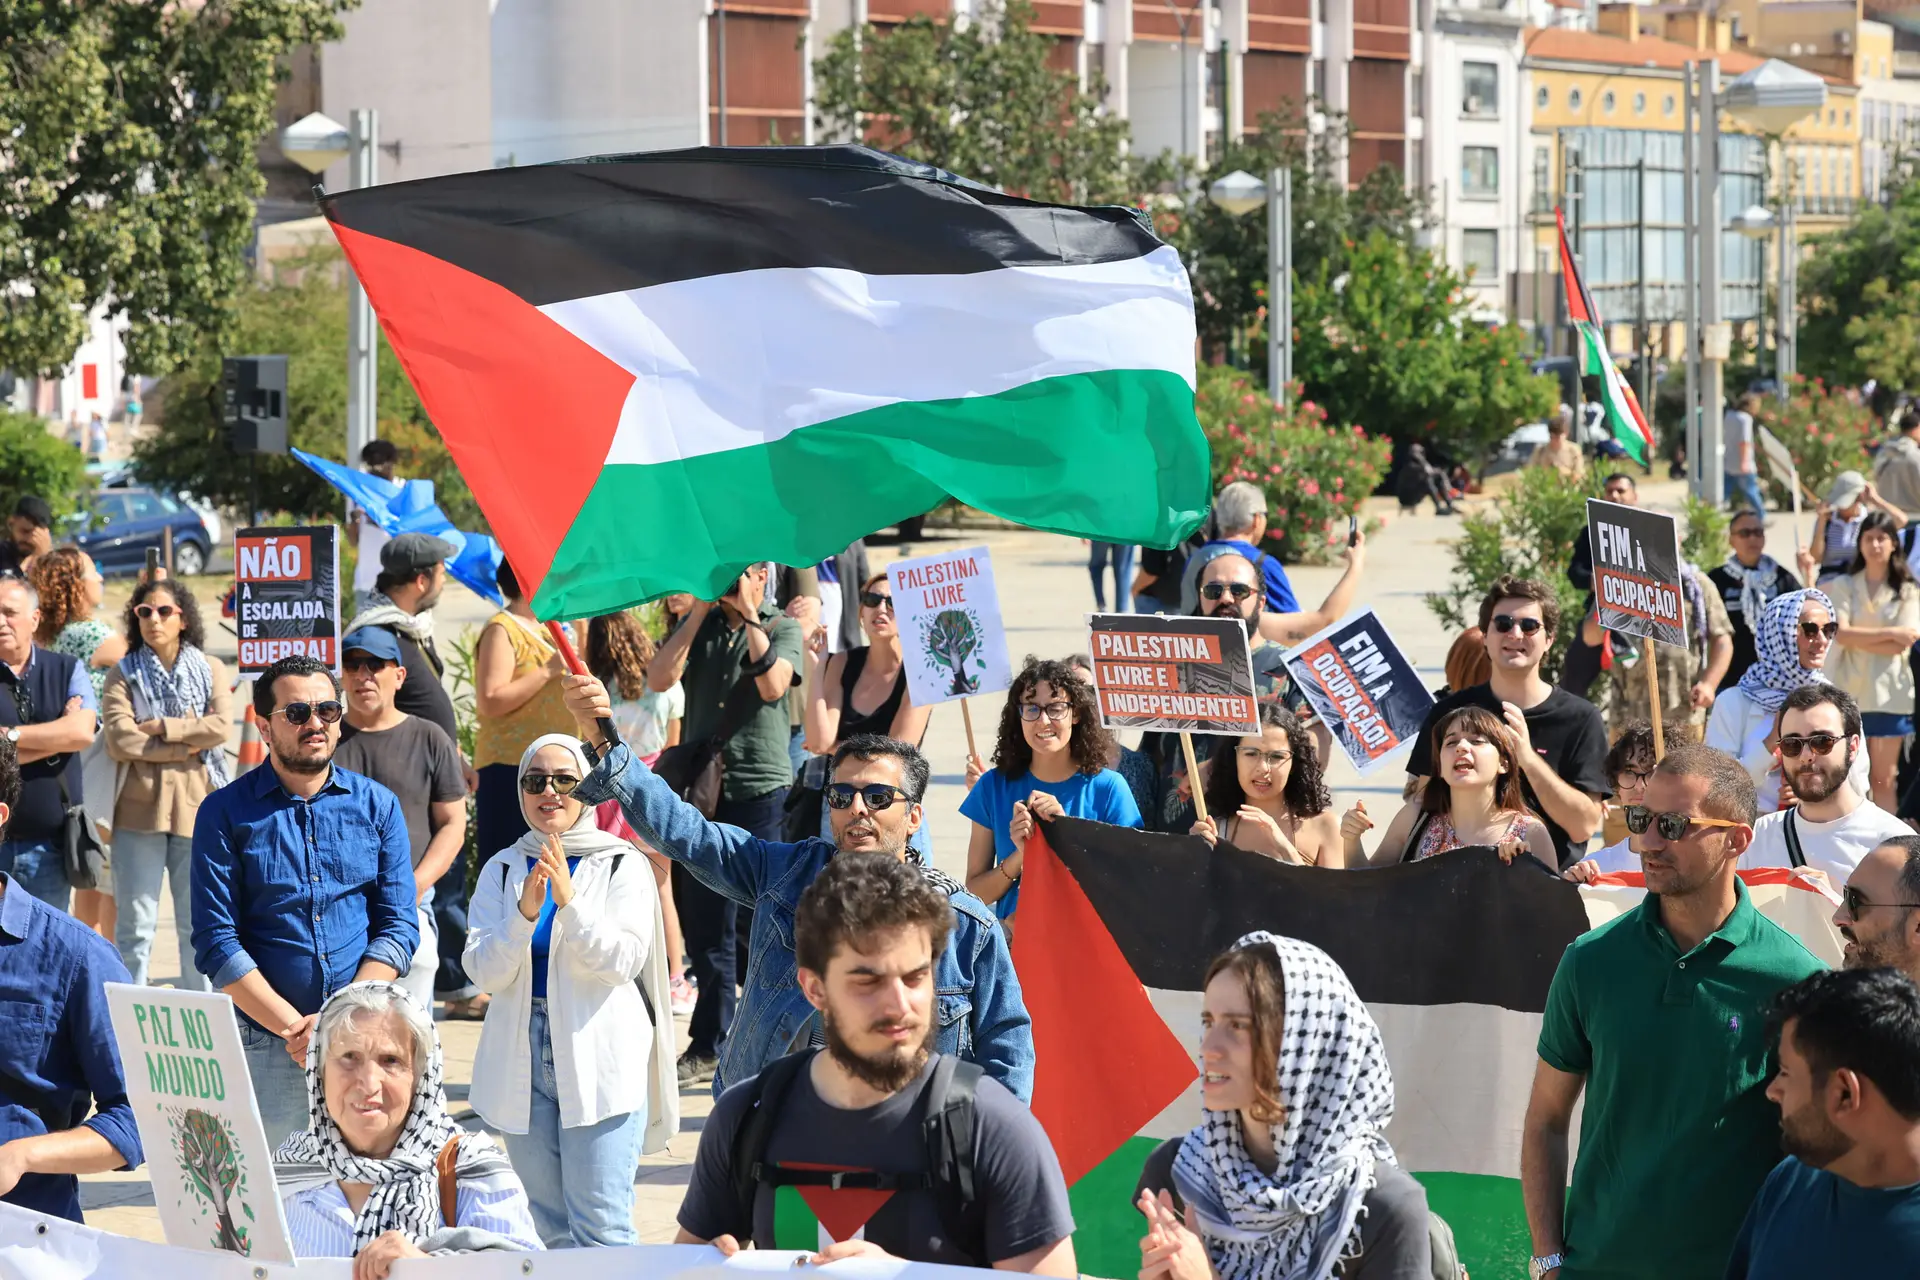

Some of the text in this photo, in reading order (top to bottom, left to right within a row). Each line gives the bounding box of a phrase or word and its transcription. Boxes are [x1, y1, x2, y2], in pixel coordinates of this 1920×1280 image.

[240, 537, 301, 579] NÃO
[1597, 521, 1647, 572] FIM À
[897, 557, 979, 591] PALESTINA
[242, 582, 252, 600] À
[923, 583, 966, 609] LIVRE
[1602, 574, 1678, 621] OCUPAÇÃO!
[242, 600, 325, 621] ESCALADA
[242, 623, 258, 638] DE
[241, 639, 327, 664] GUERRA!
[1098, 634, 1211, 660] PALESTINA
[1102, 665, 1169, 687] LIVRE E
[1338, 630, 1394, 701] FIM À
[1107, 693, 1248, 718] INDEPENDENTE!
[1312, 652, 1390, 749] OCUPAÇÃO!
[132, 1003, 213, 1051] PAZ NO
[145, 1051, 225, 1101] MUNDO
